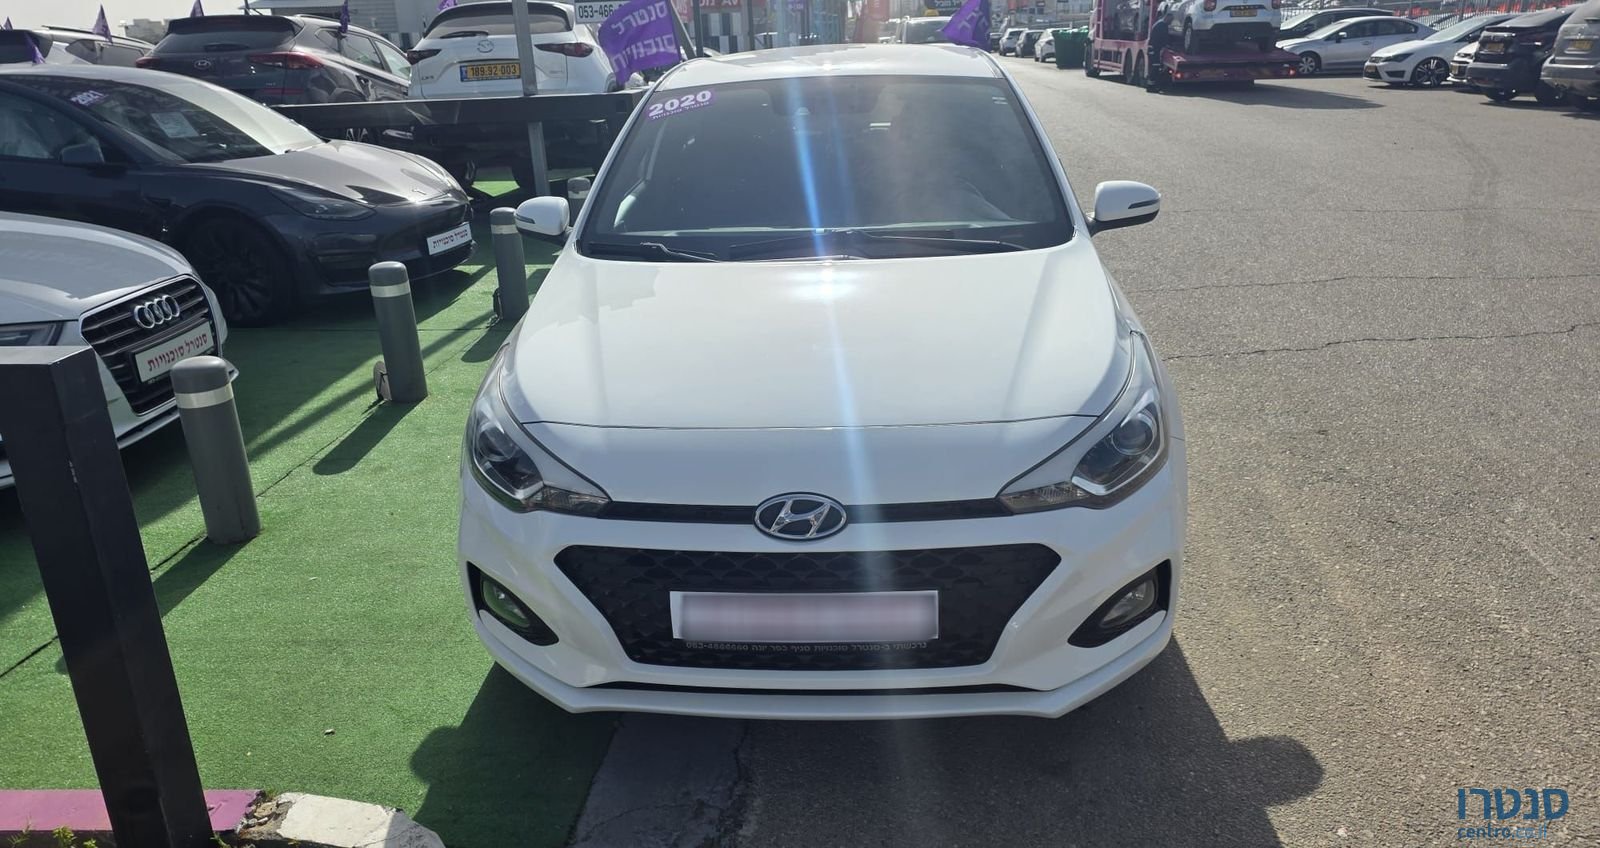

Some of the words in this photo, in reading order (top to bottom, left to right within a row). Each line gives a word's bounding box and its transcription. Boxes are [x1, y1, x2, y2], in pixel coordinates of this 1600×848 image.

[611, 1, 668, 35] סנטרל
[612, 34, 678, 73] סוכנויות
[648, 90, 712, 117] 2020
[184, 333, 209, 354] סנטרל
[147, 345, 185, 372] סוכנויות
